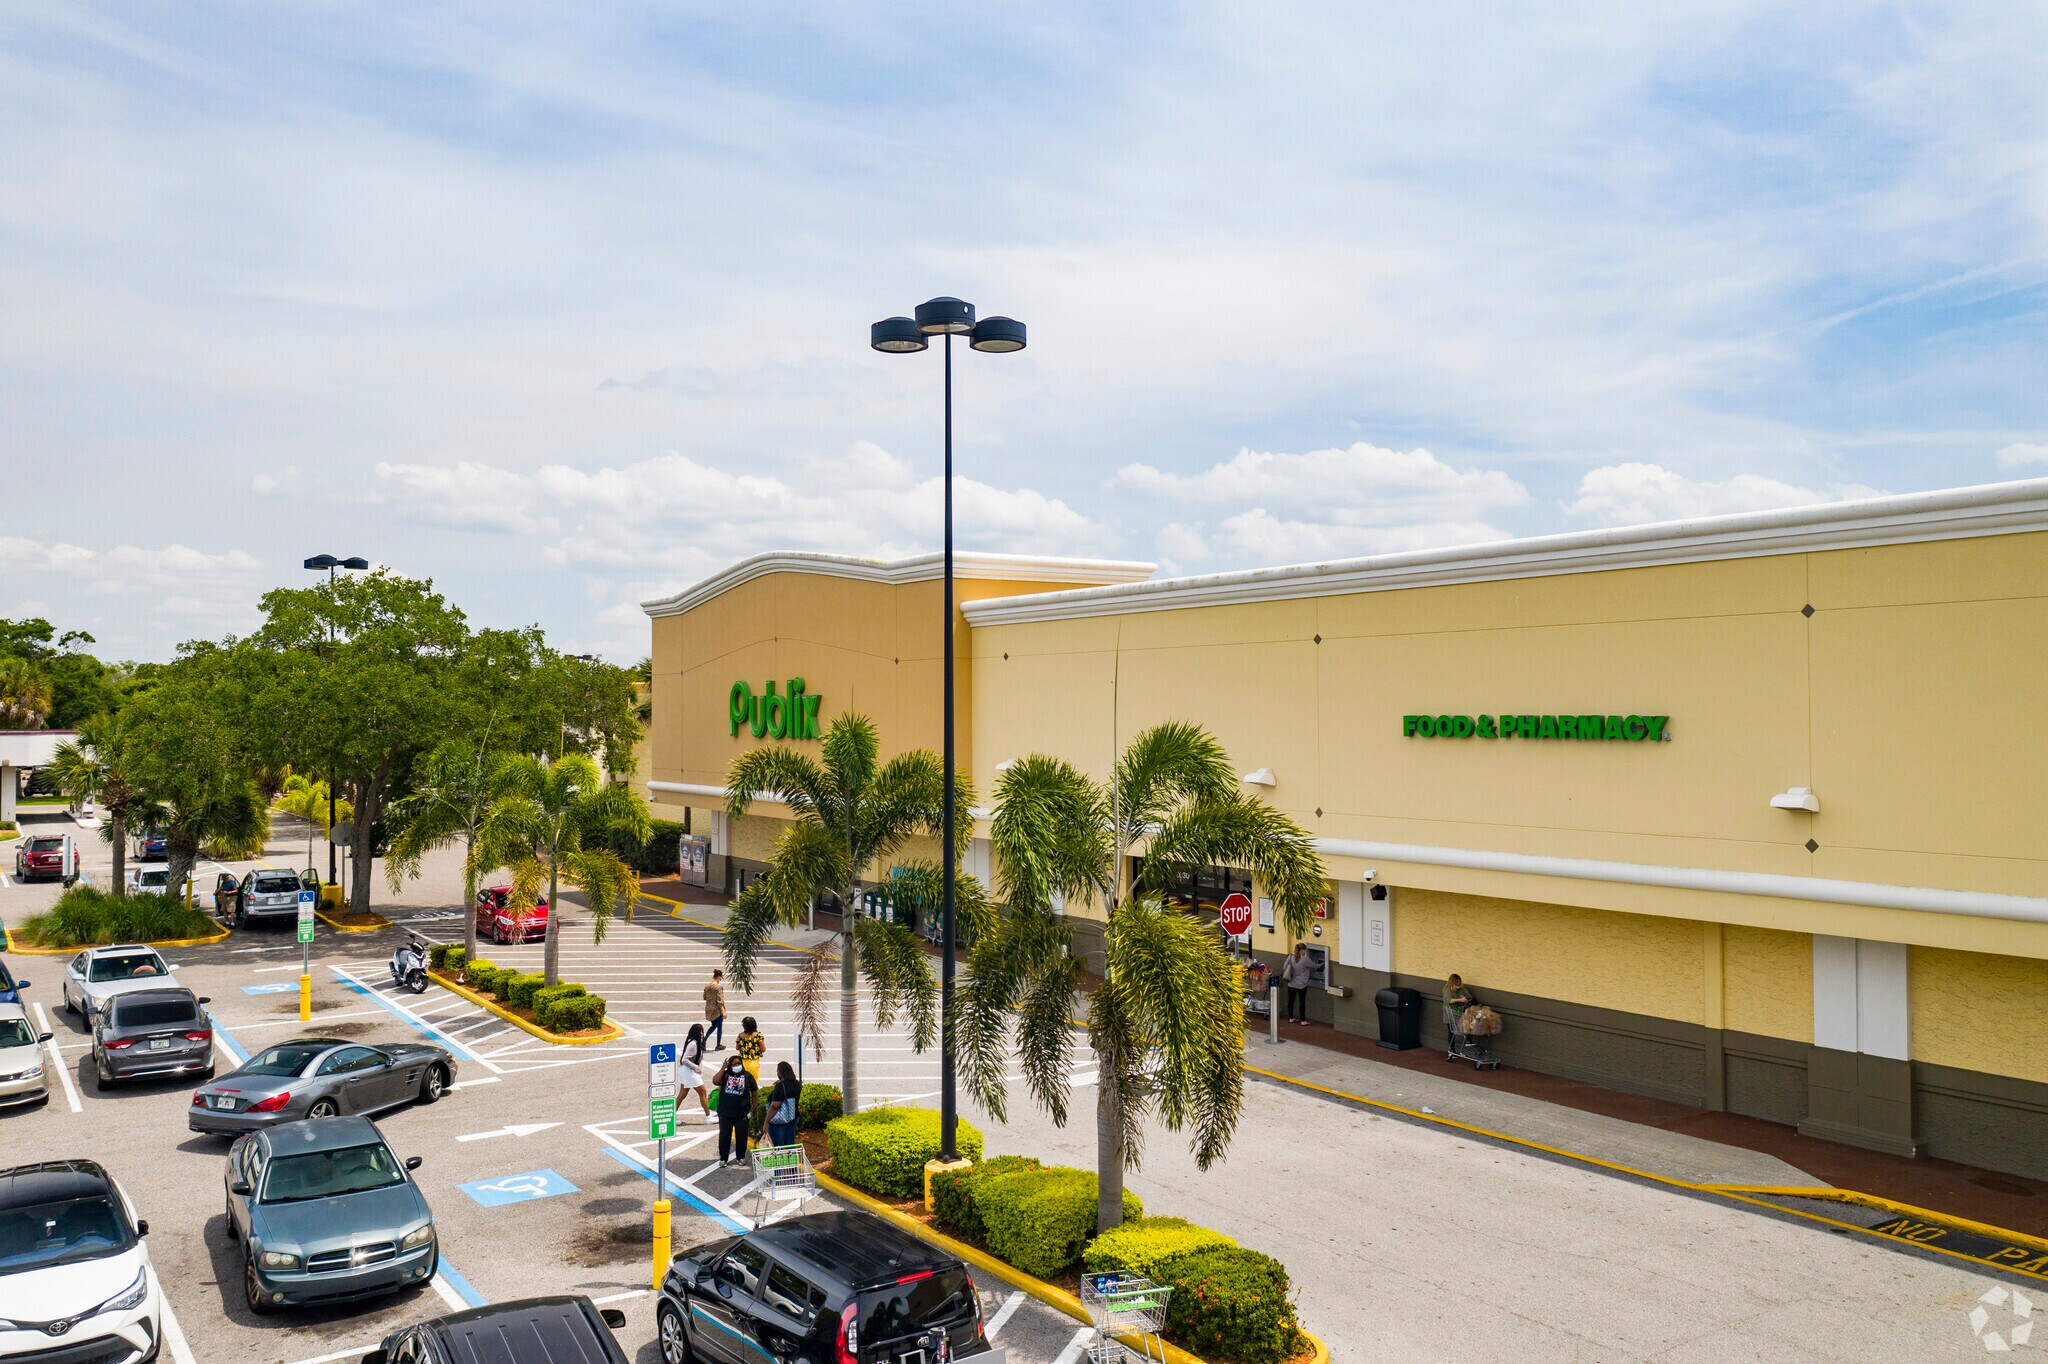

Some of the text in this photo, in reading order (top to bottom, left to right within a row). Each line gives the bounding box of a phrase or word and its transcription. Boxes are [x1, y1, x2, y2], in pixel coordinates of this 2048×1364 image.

[730, 677, 822, 739] Publix
[1403, 714, 1669, 741] FOOD & PHARMACY
[1223, 906, 1251, 924] STOP
[1878, 1219, 2048, 1276] NO PA
